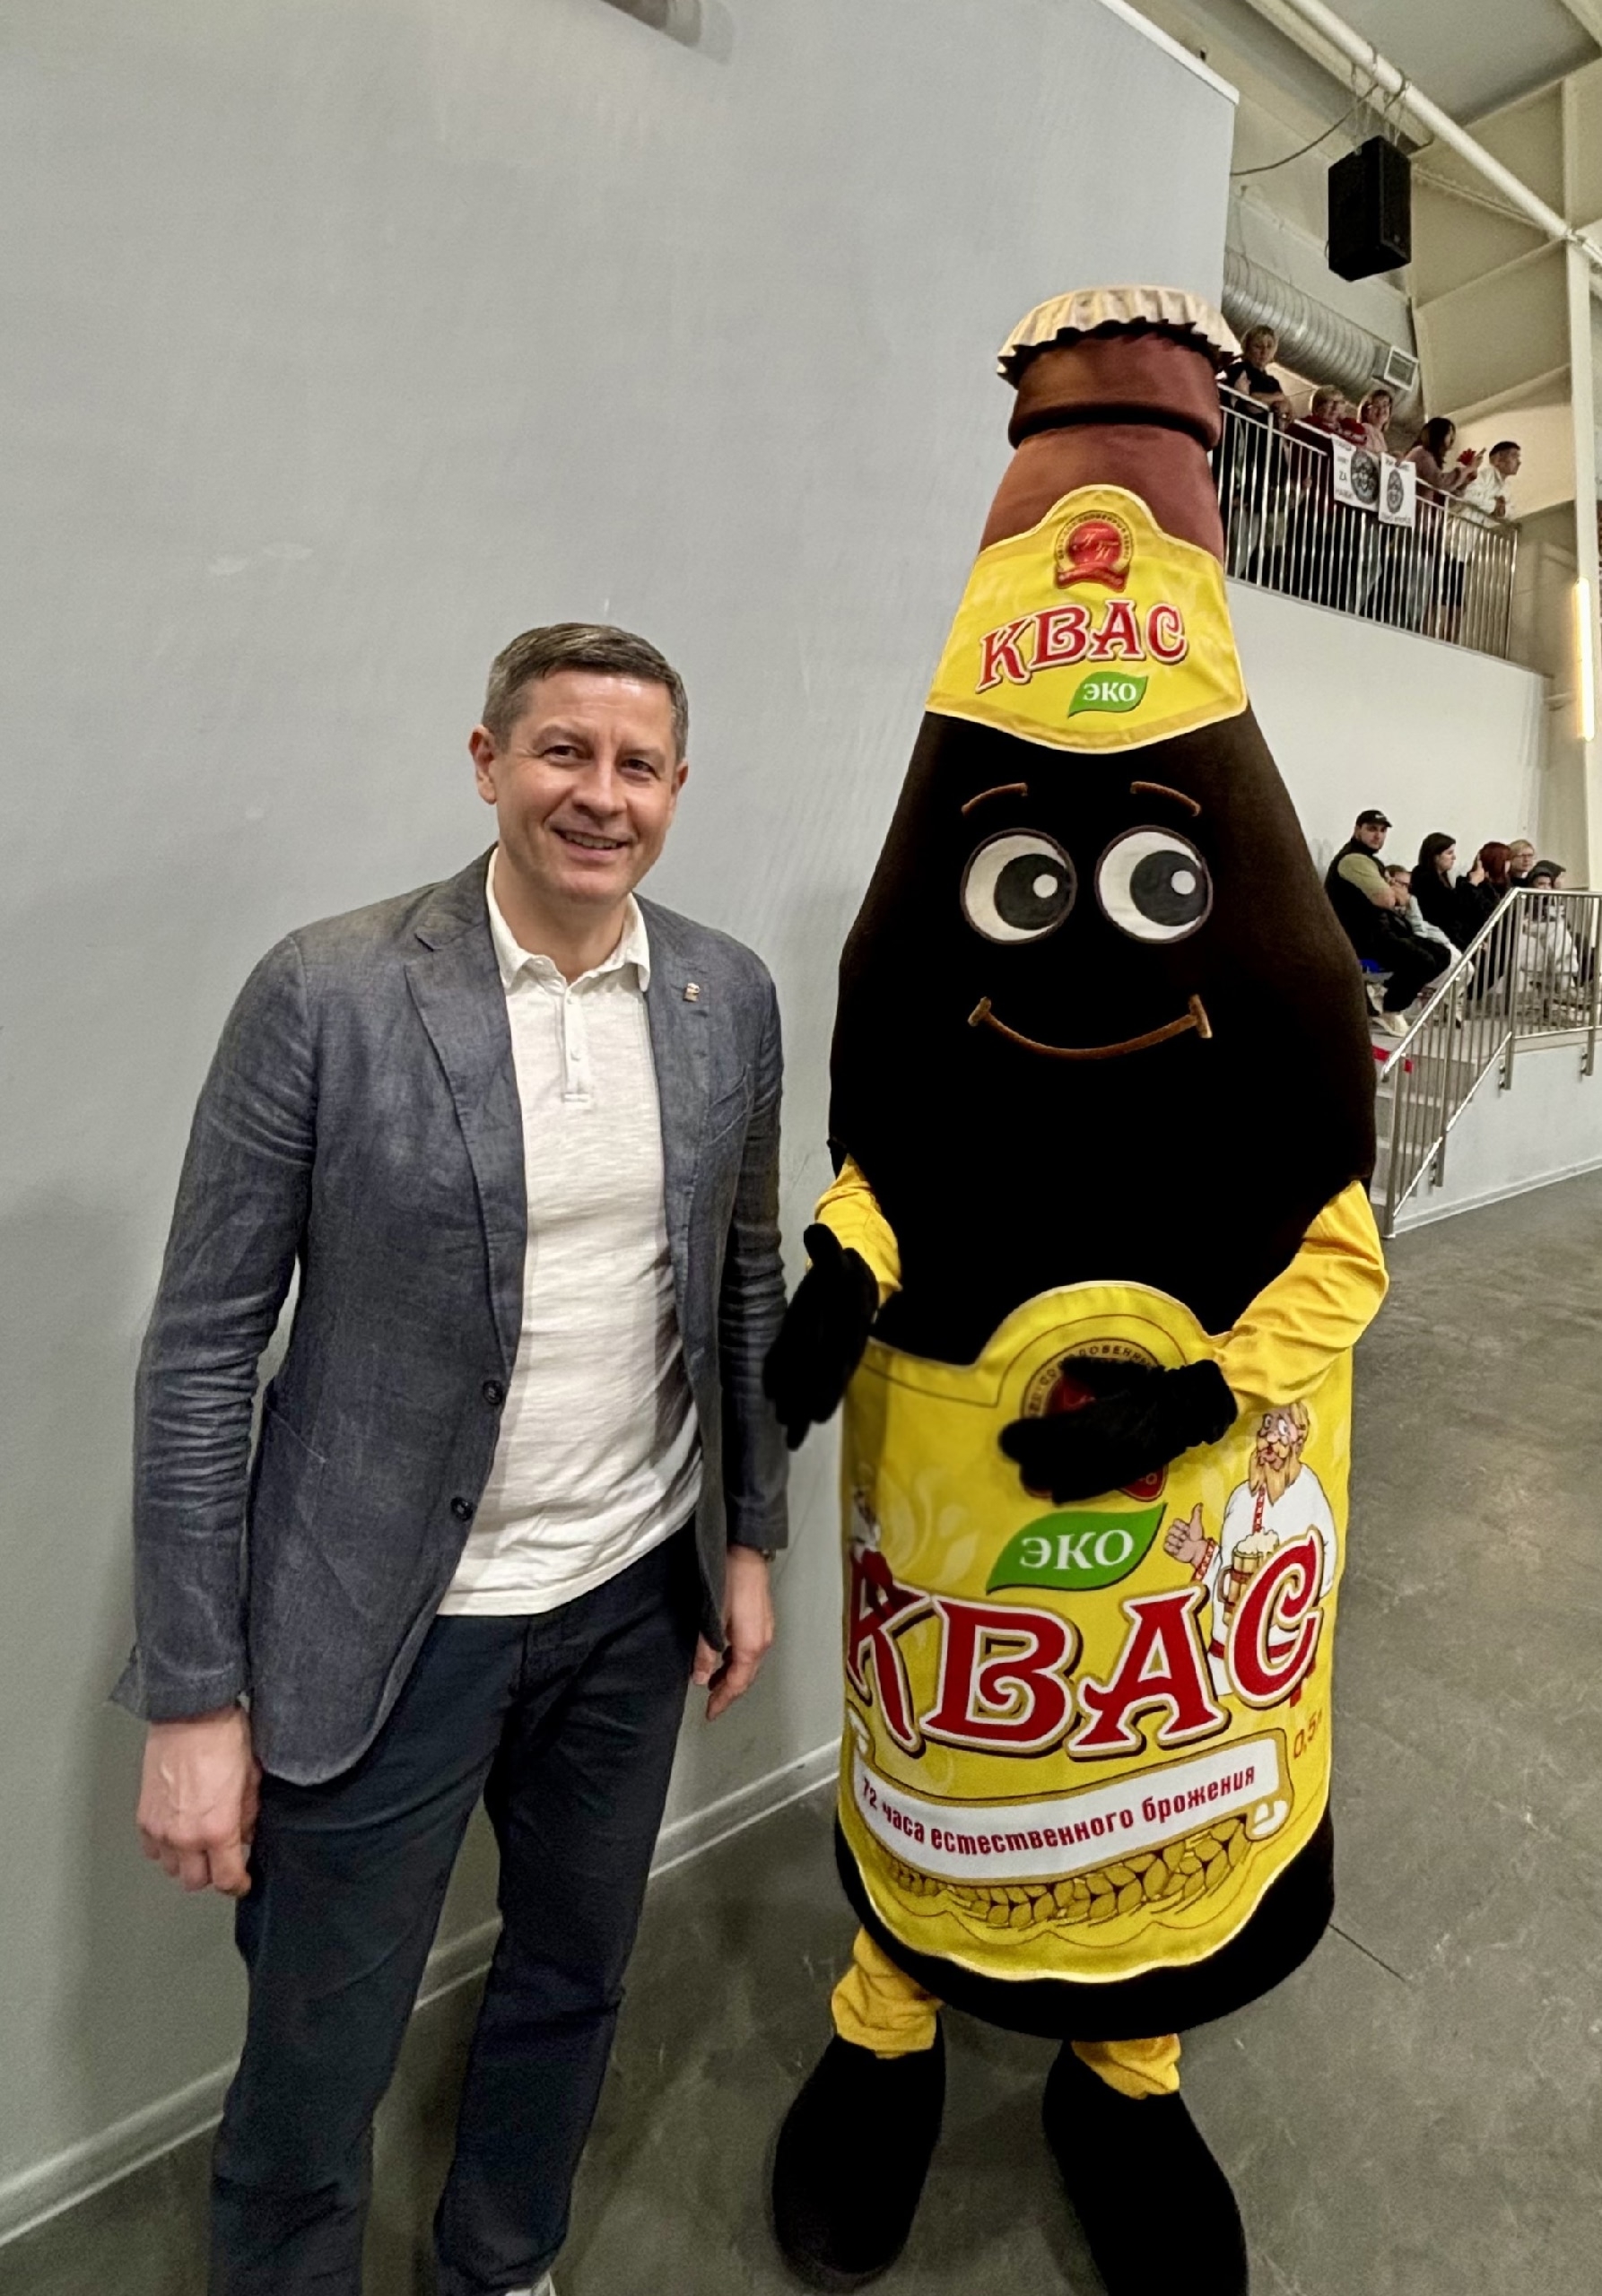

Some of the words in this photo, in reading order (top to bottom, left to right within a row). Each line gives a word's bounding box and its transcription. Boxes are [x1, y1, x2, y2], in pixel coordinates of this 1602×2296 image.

[975, 599, 1189, 694] КВАС
[1083, 681, 1137, 702] ЭКО
[1020, 1528, 1135, 1570] ЭКО
[846, 1524, 1327, 1757] КВАС
[863, 1776, 879, 1810] 72
[882, 1801, 926, 1844] часа
[930, 1808, 1135, 1856] естественного
[1141, 1765, 1256, 1824] брожения
